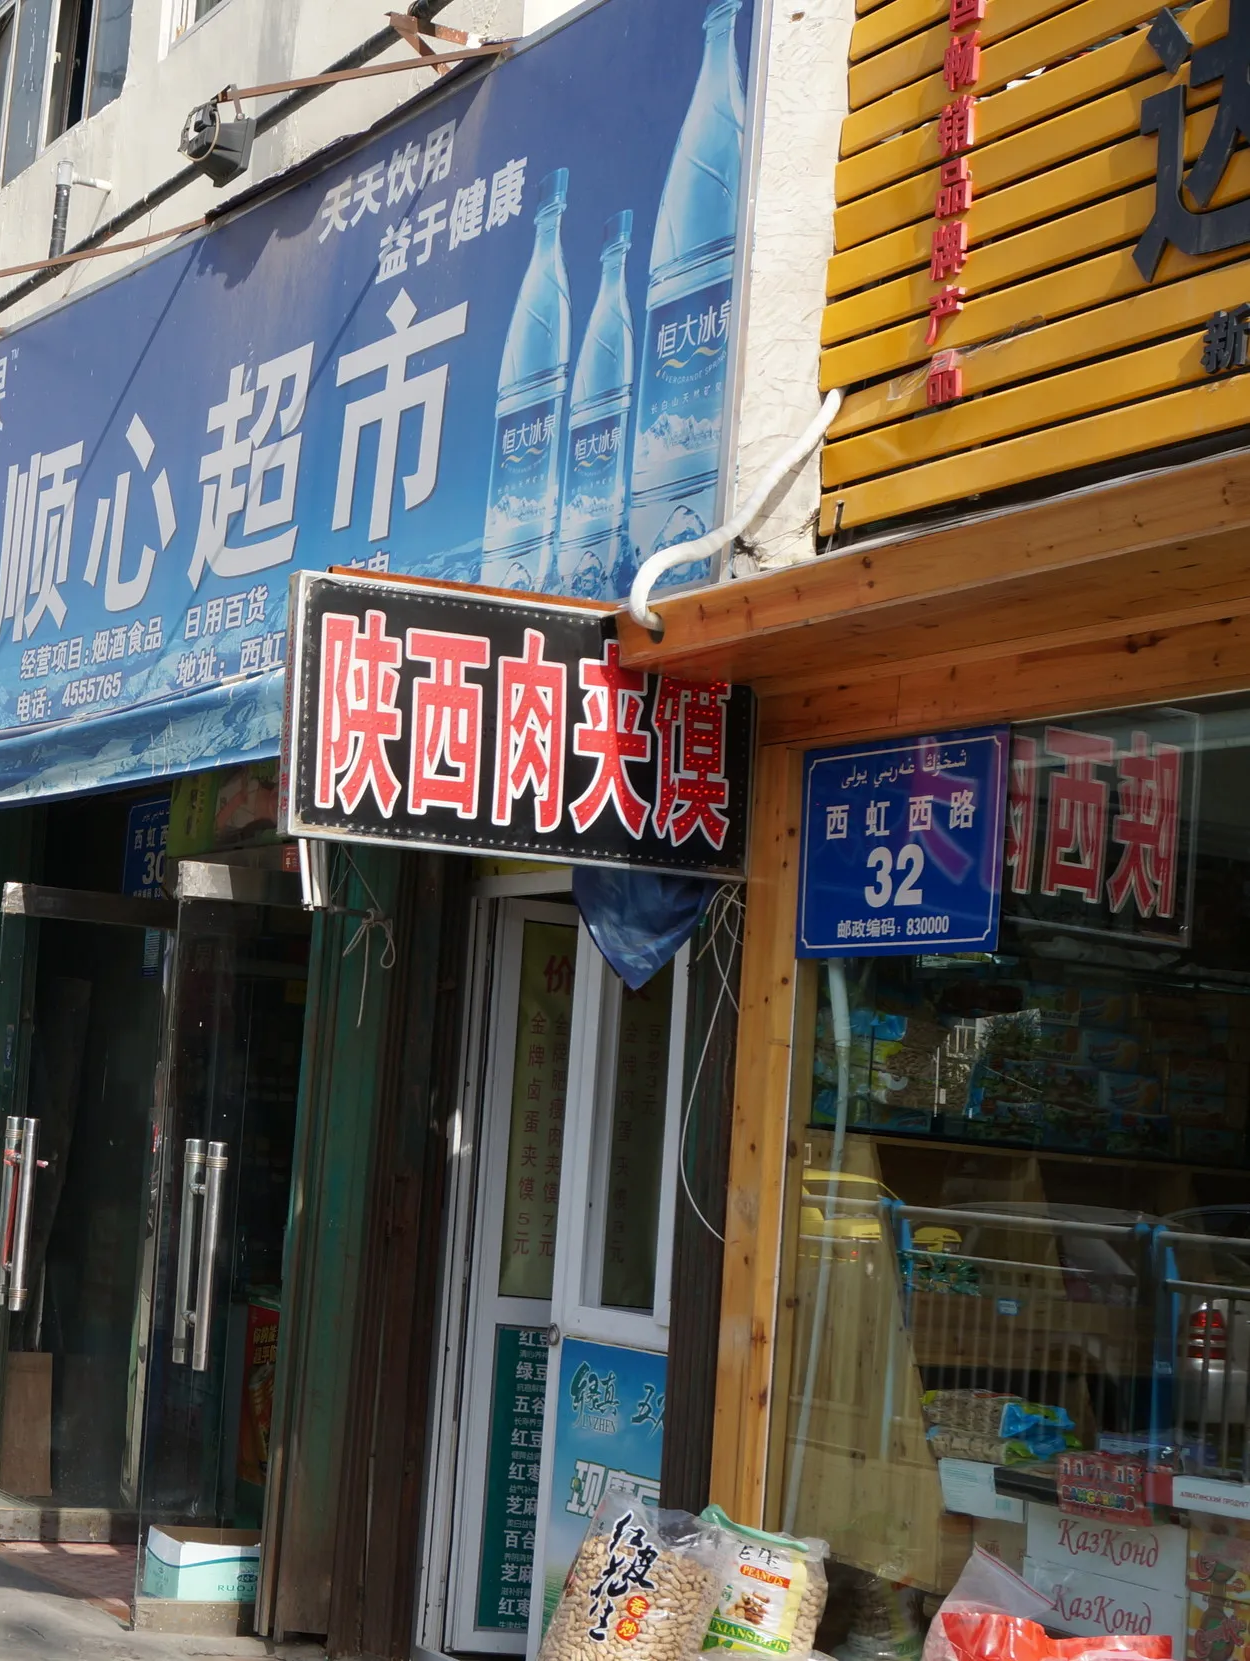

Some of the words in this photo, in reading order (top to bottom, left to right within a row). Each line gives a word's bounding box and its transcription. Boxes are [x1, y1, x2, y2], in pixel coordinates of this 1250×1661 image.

[317, 118, 457, 244] 天天饮用
[375, 156, 528, 285] 益于健康
[183, 583, 270, 641] 日用百货
[61, 672, 123, 709] 4555765
[313, 608, 732, 851] 陕西肉夹馍
[825, 789, 976, 841] 西虹西路
[864, 843, 926, 909] 32
[905, 914, 950, 936] 830000
[515, 1362, 548, 1381] 绿豆
[503, 1530, 535, 1549] 百合
[1057, 1518, 1160, 1568] КазКонд
[742, 1565, 785, 1588] PEANUTS
[1050, 1583, 1153, 1636] КазКонд
